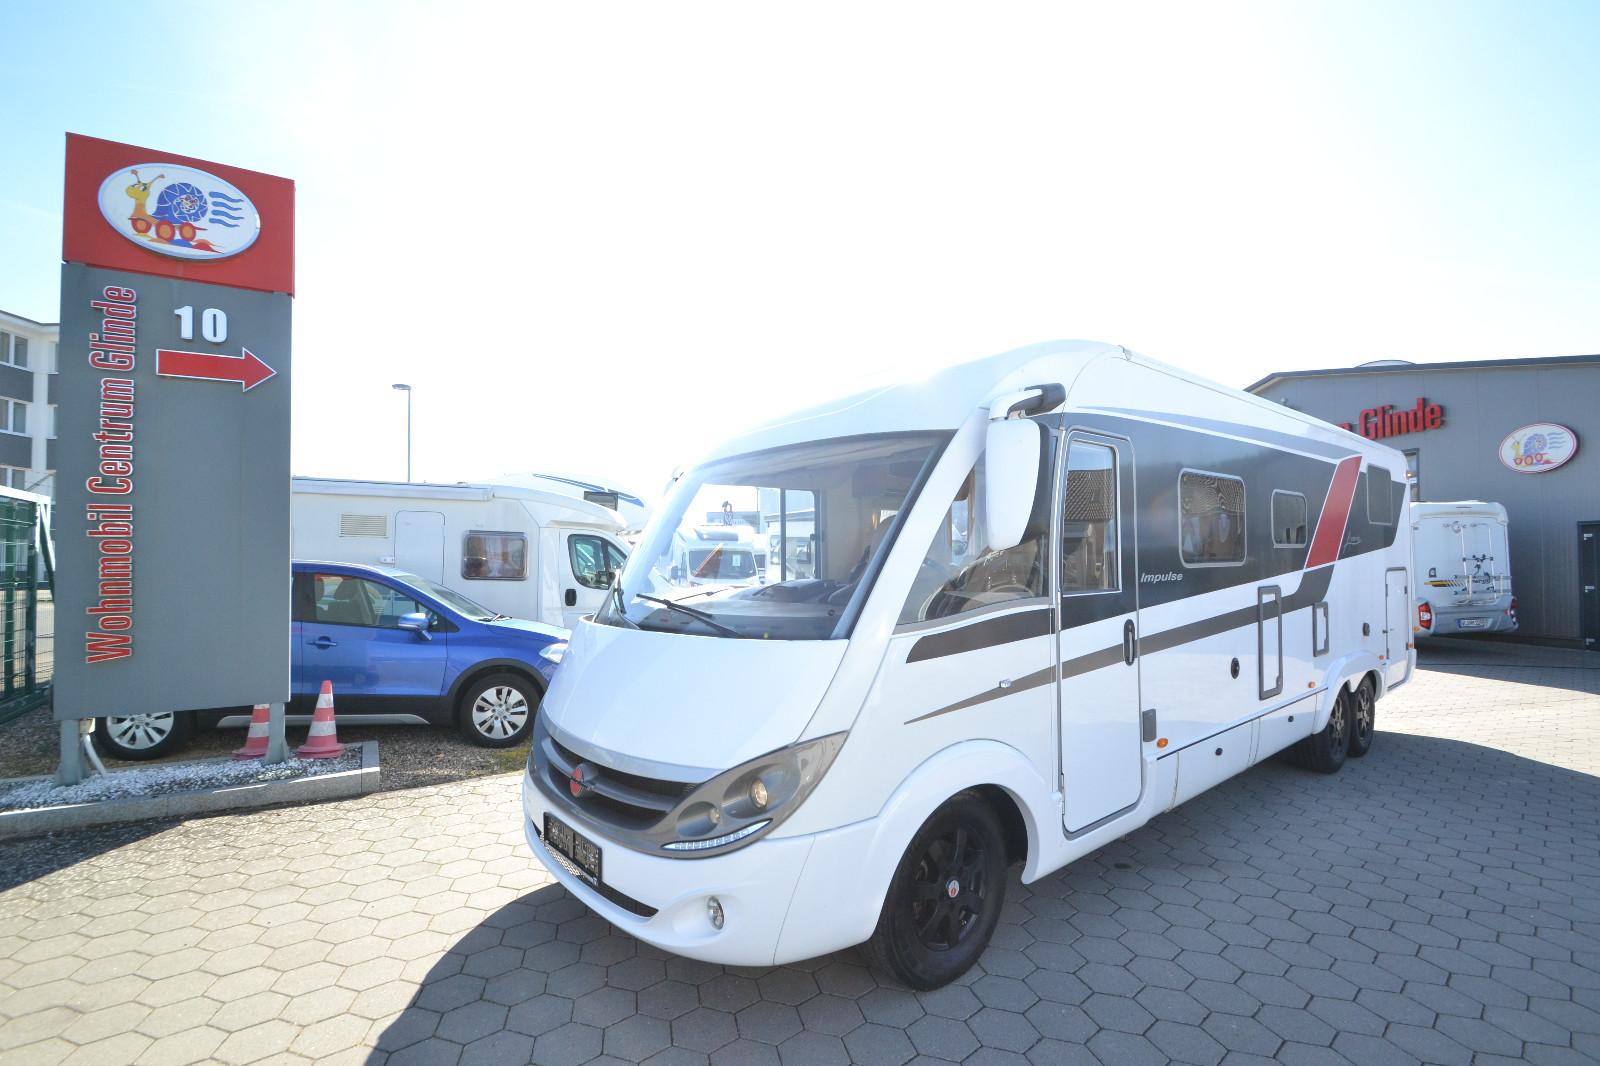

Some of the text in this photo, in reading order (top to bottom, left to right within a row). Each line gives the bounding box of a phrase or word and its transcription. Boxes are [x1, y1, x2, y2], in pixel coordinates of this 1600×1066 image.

[174, 305, 228, 343] 10
[1359, 397, 1442, 441] Glinde
[86, 285, 137, 664] Wohnmobil Centrum Glinde
[1140, 571, 1184, 584] Impulse
